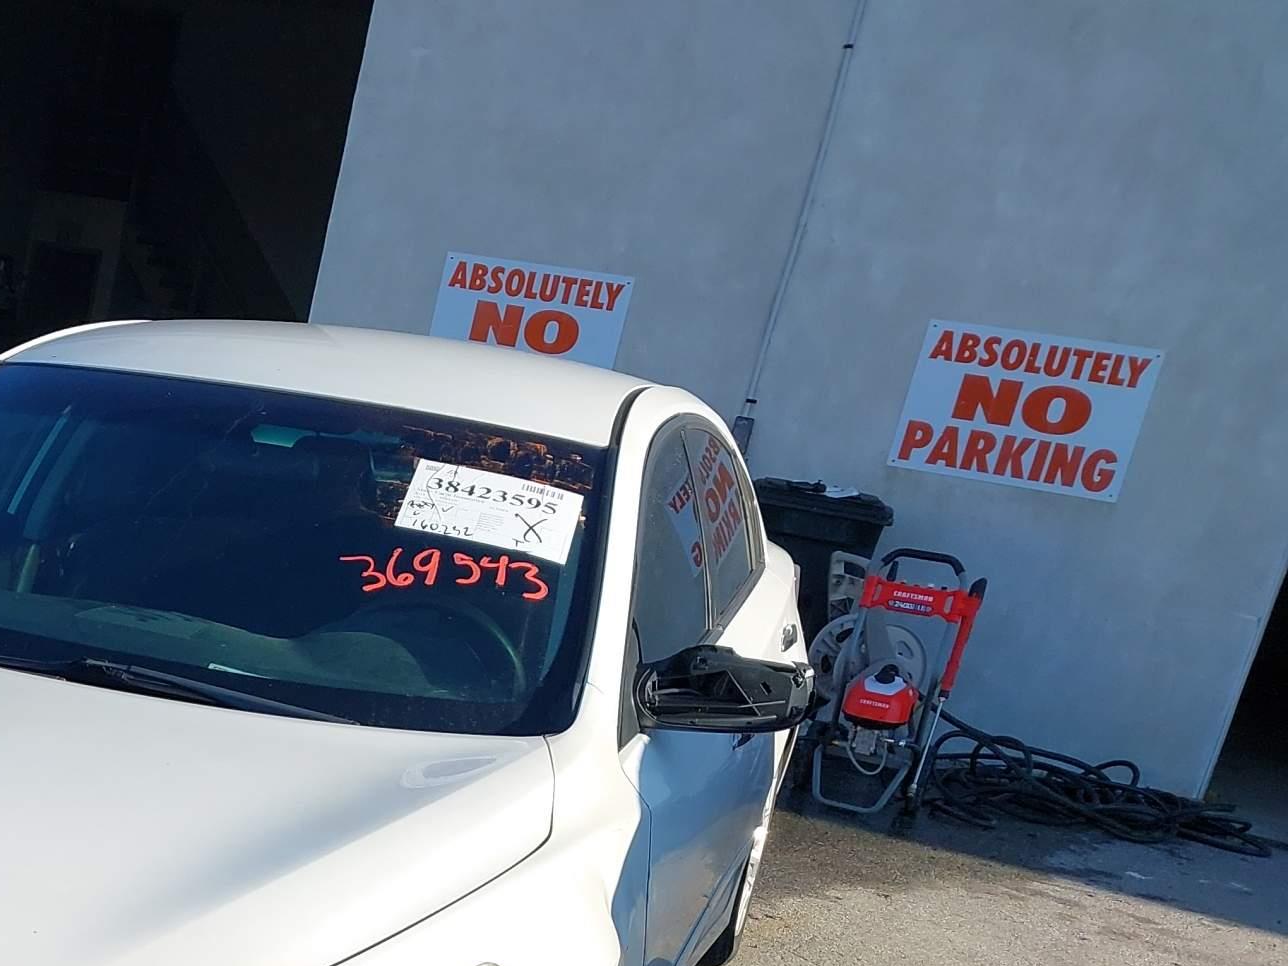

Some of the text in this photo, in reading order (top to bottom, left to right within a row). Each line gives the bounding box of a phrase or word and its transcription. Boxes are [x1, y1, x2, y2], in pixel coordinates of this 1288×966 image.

[448, 261, 625, 311] ABSOLUTELY
[469, 299, 579, 355] NO
[928, 330, 1153, 388] ABSOLUTELY
[951, 373, 1092, 435] NO
[898, 419, 1118, 492] PARKING
[427, 478, 559, 514] 38423595
